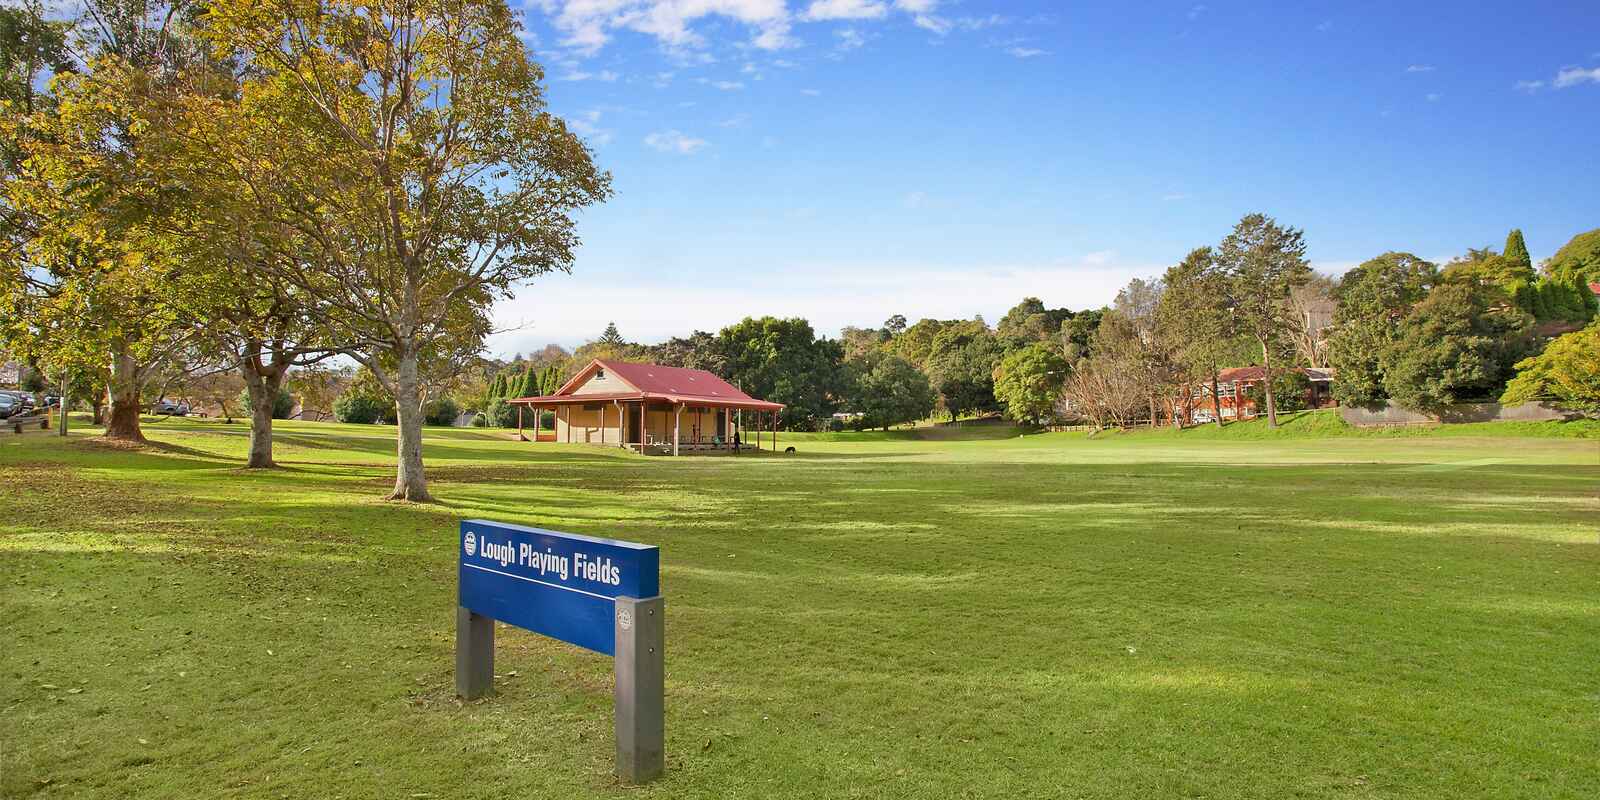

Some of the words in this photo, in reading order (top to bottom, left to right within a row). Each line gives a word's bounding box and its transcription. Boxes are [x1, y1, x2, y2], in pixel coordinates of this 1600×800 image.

[481, 536, 515, 567] Lough
[520, 543, 568, 581] Playing
[574, 553, 620, 586] Fields
